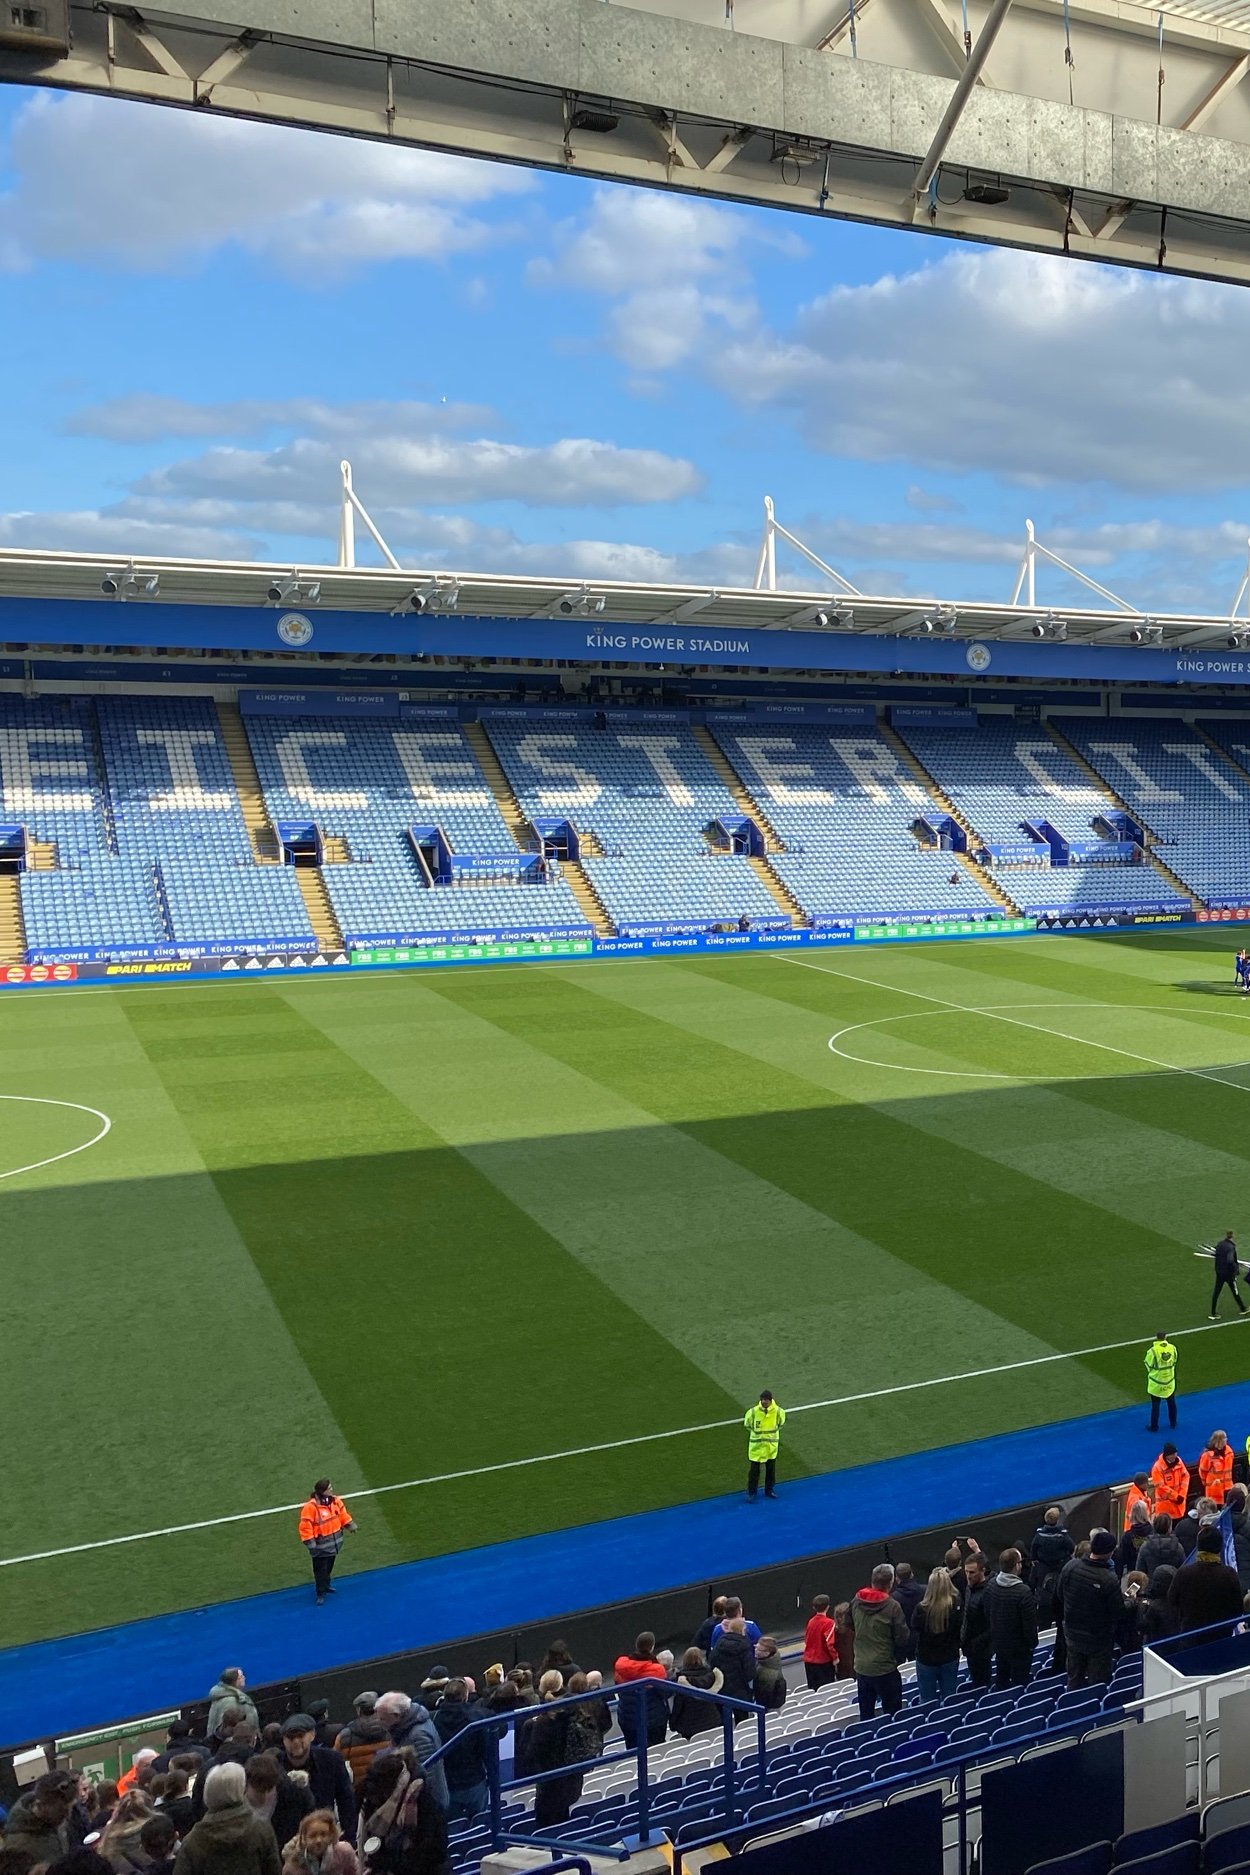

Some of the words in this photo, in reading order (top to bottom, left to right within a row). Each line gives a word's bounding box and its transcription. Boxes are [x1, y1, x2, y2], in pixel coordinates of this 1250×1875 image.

[586, 635, 627, 648] KING
[631, 637, 685, 650] POWER
[689, 639, 750, 653] STADIUM
[1176, 661, 1204, 672] KING
[1207, 662, 1244, 673] POWER
[278, 694, 306, 702] POWER
[358, 695, 385, 703] POWER
[472, 859, 492, 867] KING
[493, 858, 520, 866] POWER
[726, 936, 750, 944] POWER
[758, 935, 776, 943] KING
[266, 943, 287, 951] KING
[288, 942, 316, 950] POWER
[597, 943, 616, 951] KING
[617, 942, 643, 950] POWER
[652, 940, 671, 948] KING
[116, 965, 141, 974] PARI
[153, 962, 192, 973] MATCH
